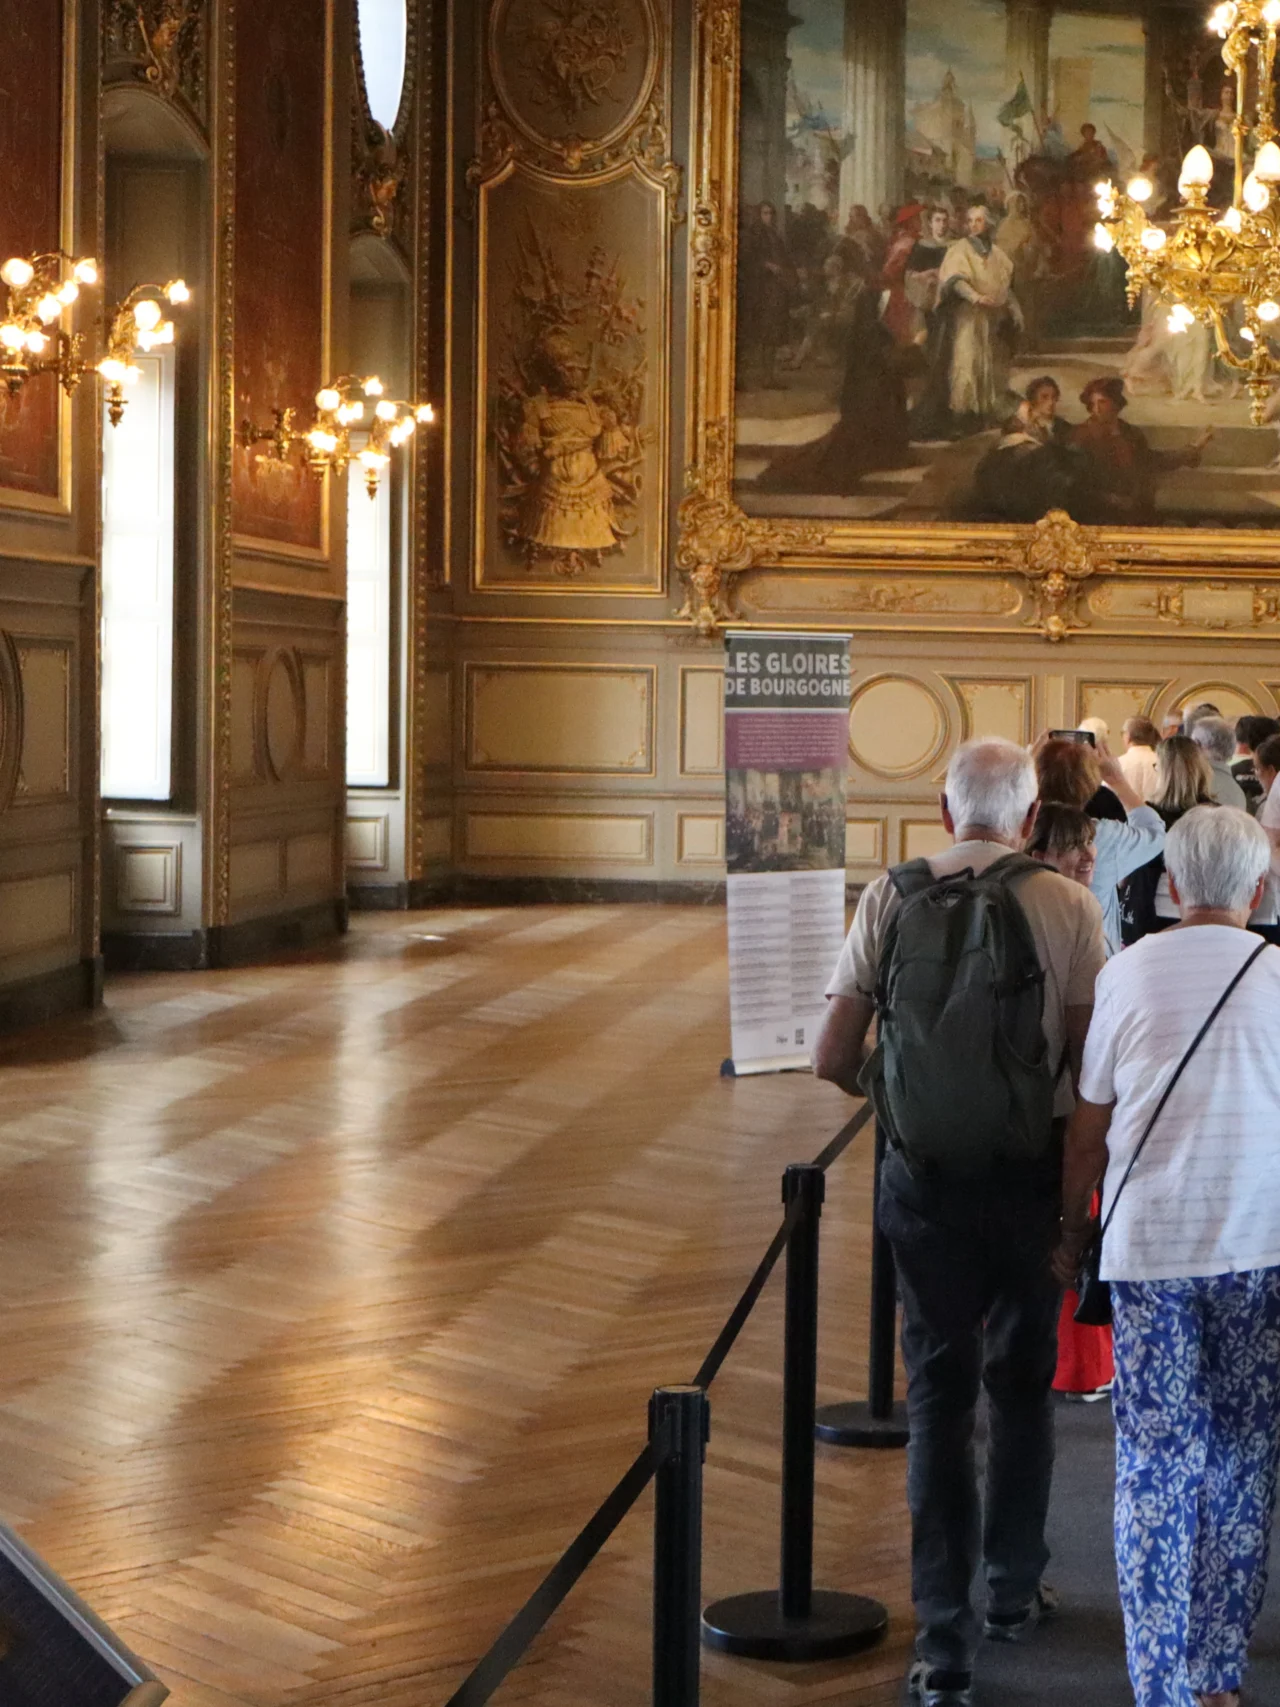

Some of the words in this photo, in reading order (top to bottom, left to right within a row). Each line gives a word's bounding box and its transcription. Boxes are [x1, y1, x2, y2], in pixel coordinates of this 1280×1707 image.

[724, 652, 761, 674] LES
[765, 652, 851, 675] GLOIRES
[724, 677, 746, 695] DE
[750, 678, 851, 696] BOURGOGNE
